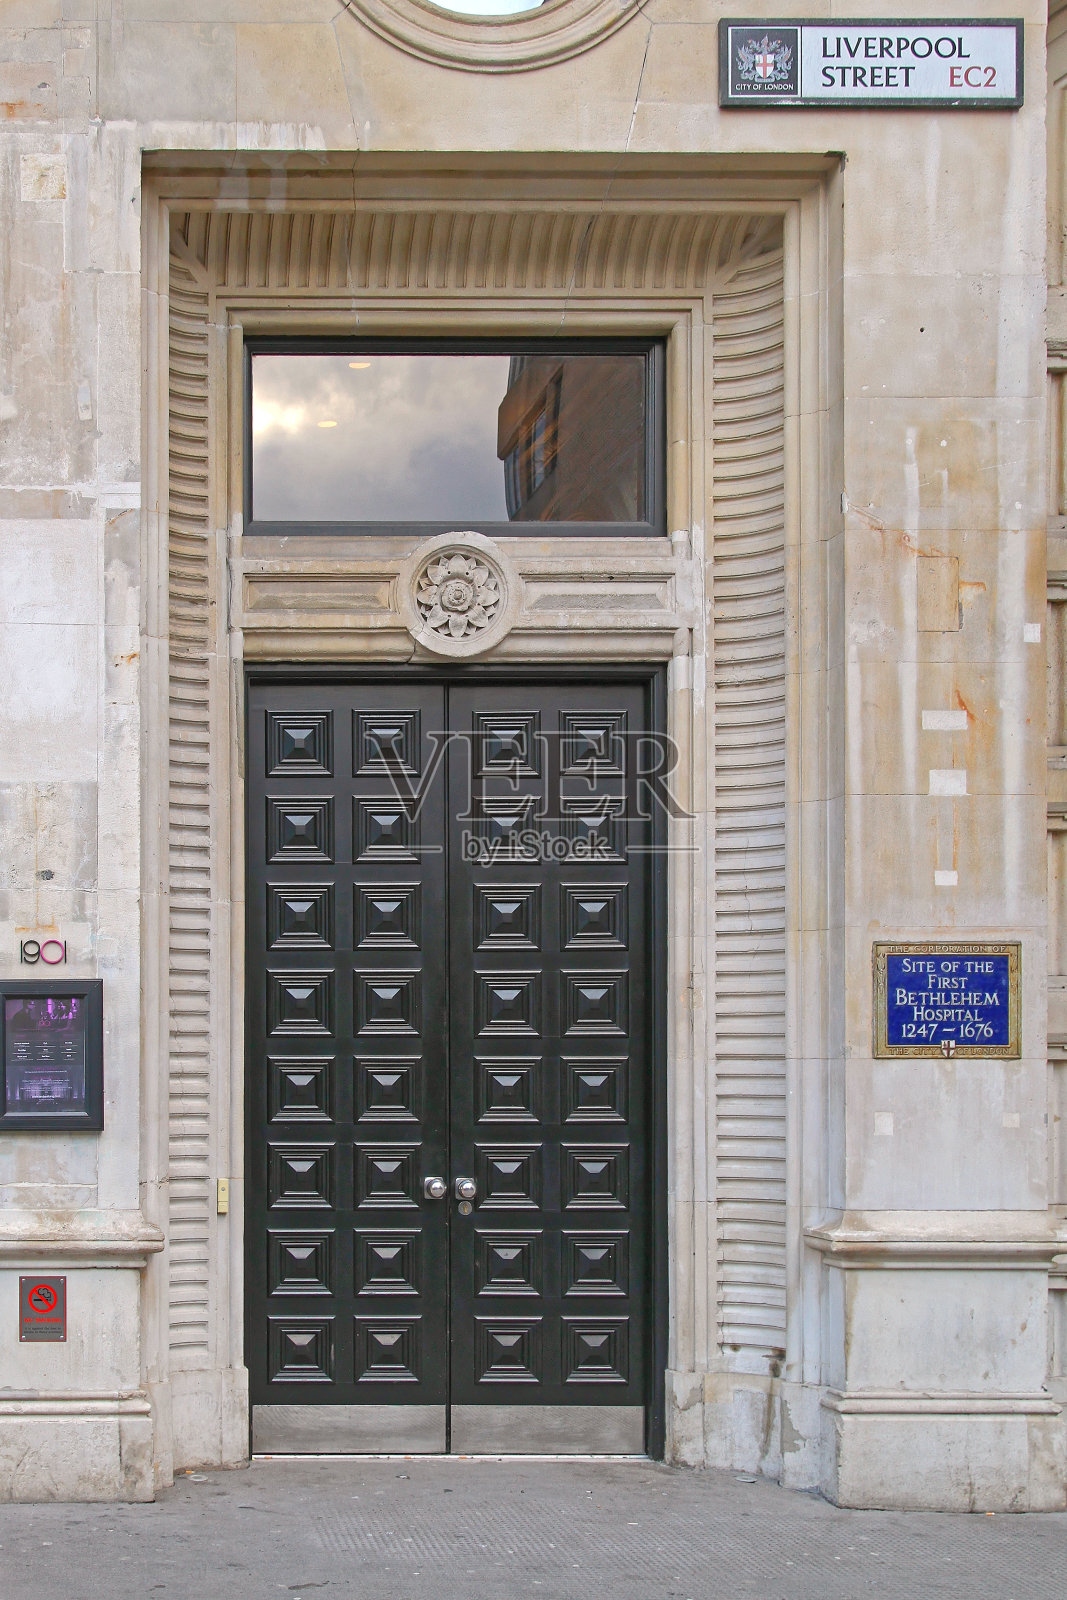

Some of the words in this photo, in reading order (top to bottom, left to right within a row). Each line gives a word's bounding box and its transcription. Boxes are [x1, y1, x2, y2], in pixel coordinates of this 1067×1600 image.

[821, 36, 970, 59] LIVERPOOL
[821, 66, 915, 88] STREET
[948, 65, 997, 88] EC2
[735, 83, 751, 91] CITY
[752, 83, 762, 91] OF
[764, 83, 794, 91] LONDON
[888, 945, 909, 953] THE
[913, 945, 988, 953] CORPORATION
[992, 945, 1007, 953] OF
[902, 958, 935, 973] SITE
[940, 961, 961, 973] OF
[964, 961, 994, 973] THE
[928, 974, 968, 989] FIRST
[895, 988, 1000, 1006] BETHLEHEM
[913, 1006, 983, 1022] HOSPITAL
[901, 1023, 938, 1041] 1247
[959, 1021, 994, 1041] 1676
[889, 1047, 909, 1056] THE
[913, 1047, 937, 1056] CITY
[956, 1047, 967, 1056] OF
[971, 1047, 1009, 1056] LONDON
